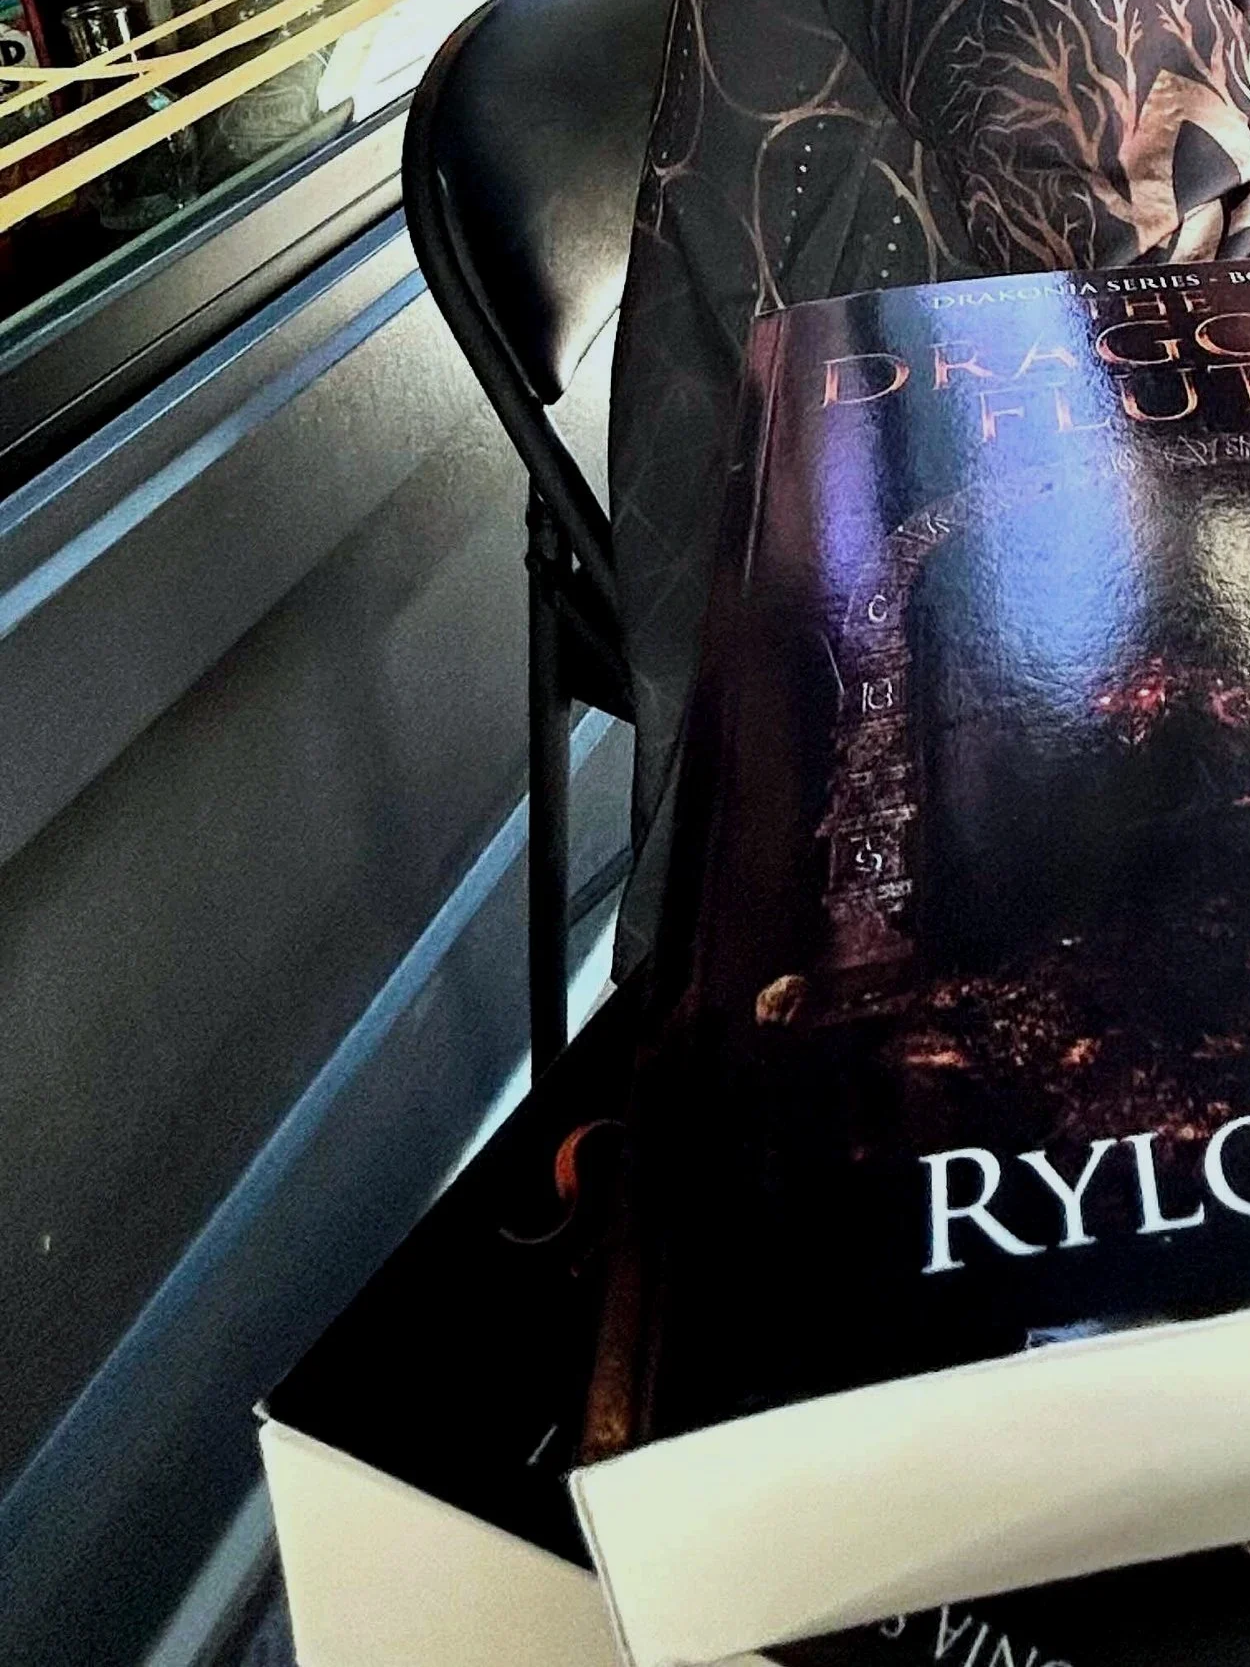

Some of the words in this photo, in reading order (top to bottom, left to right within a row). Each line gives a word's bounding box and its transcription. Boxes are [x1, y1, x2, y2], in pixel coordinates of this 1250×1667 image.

[931, 280, 1099, 310] DRAKONIA
[1106, 272, 1202, 294] SERIES
[1086, 289, 1214, 321] THE
